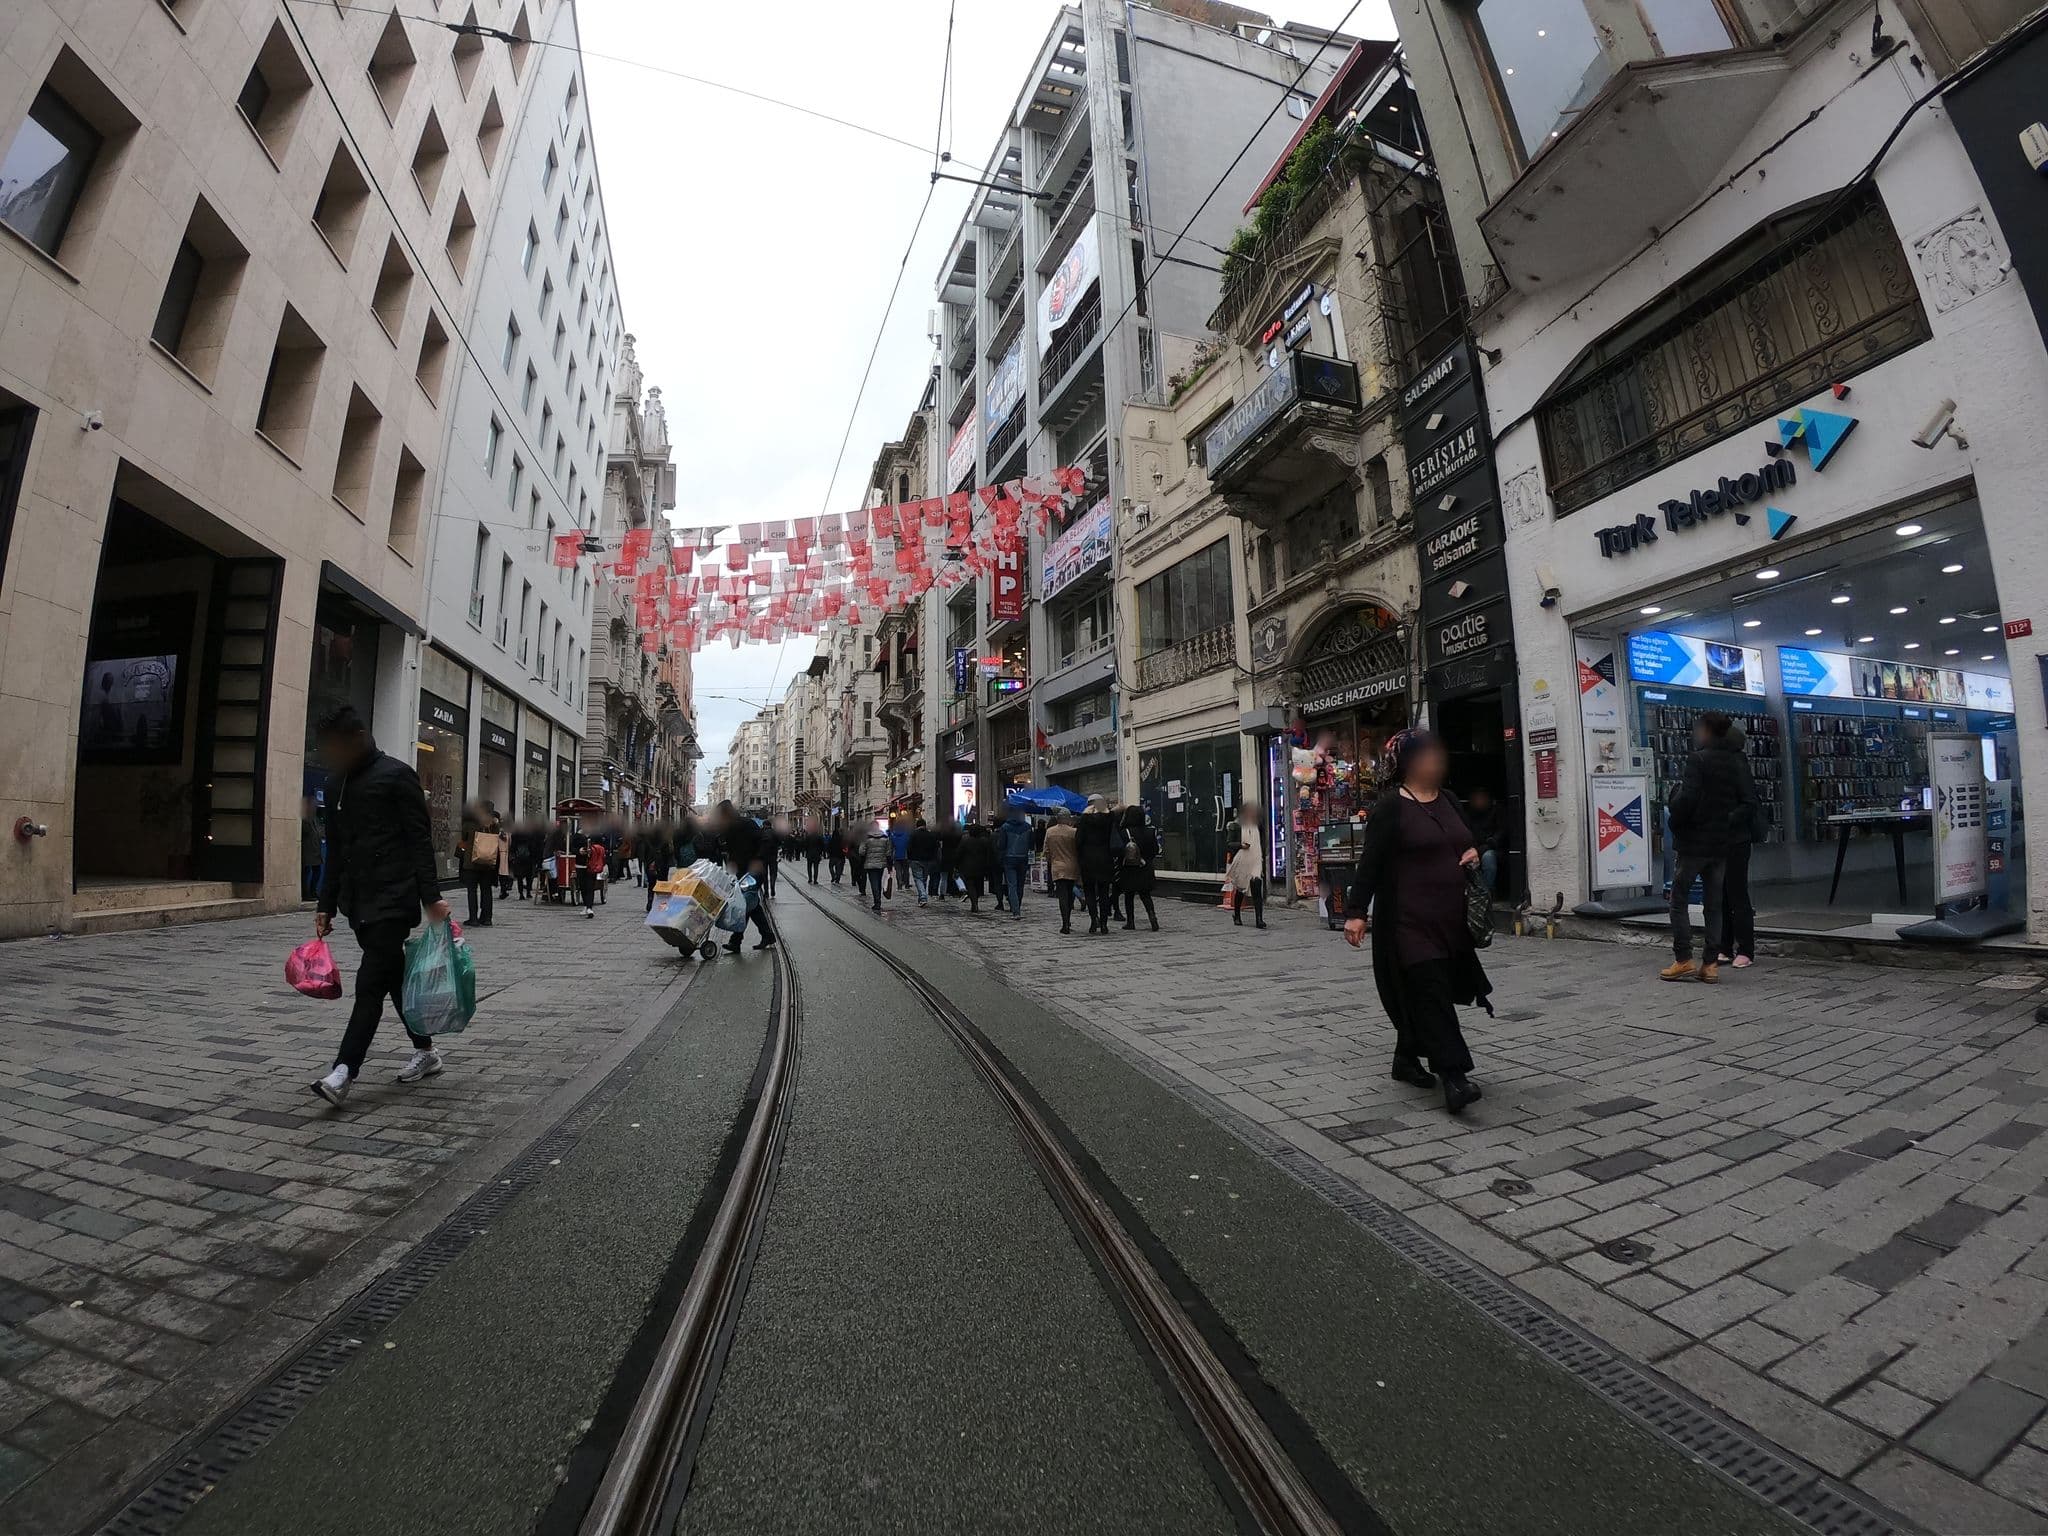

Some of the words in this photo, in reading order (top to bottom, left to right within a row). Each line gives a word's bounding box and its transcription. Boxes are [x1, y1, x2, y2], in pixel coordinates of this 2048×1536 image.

[1405, 356, 1454, 408] SALSANAT
[1411, 426, 1476, 485] FERİŞTAH
[1415, 473, 1445, 496] ANTAKYA
[1594, 513, 1659, 559] Türk
[1658, 459, 1797, 533] Telekom
[1427, 516, 1480, 556] KARAOKE
[1433, 537, 1477, 571] salsanat
[998, 551, 1017, 595] HP
[1441, 614, 1486, 654] partie
[1446, 641, 1468, 656] MUSIC
[1468, 633, 1488, 648] CLUB
[1303, 692, 1344, 714] PASSAGE
[1345, 675, 1407, 702] HAZZOPULO
[433, 707, 454, 725] ZARA
[491, 733, 506, 747] ZARA
